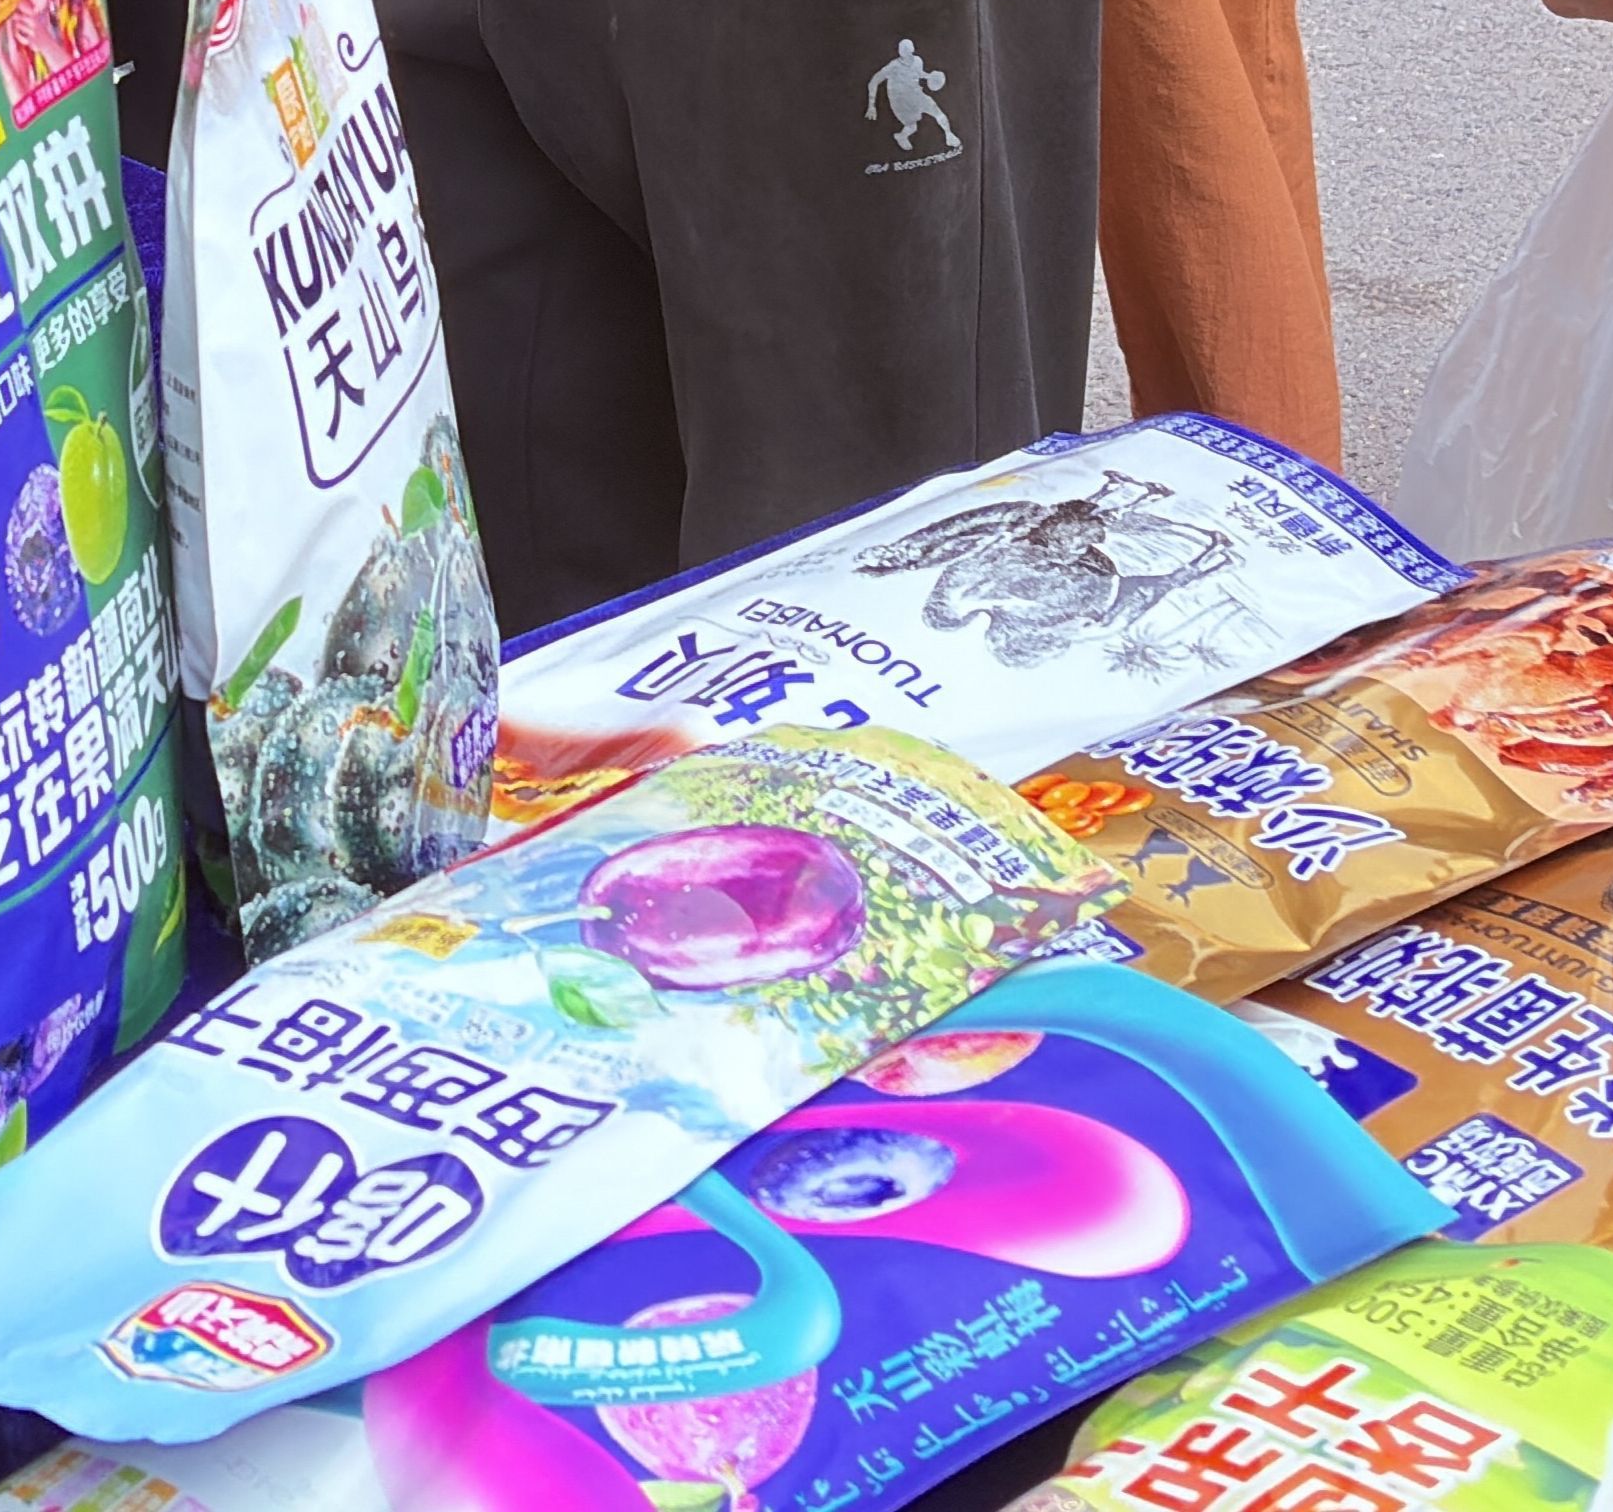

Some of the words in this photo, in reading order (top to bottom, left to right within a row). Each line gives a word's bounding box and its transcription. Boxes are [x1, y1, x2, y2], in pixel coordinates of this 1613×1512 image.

[32, 260, 131, 377] 更多的享受
[306, 216, 434, 441] 天山乌
[615, 632, 873, 731] 奶贝
